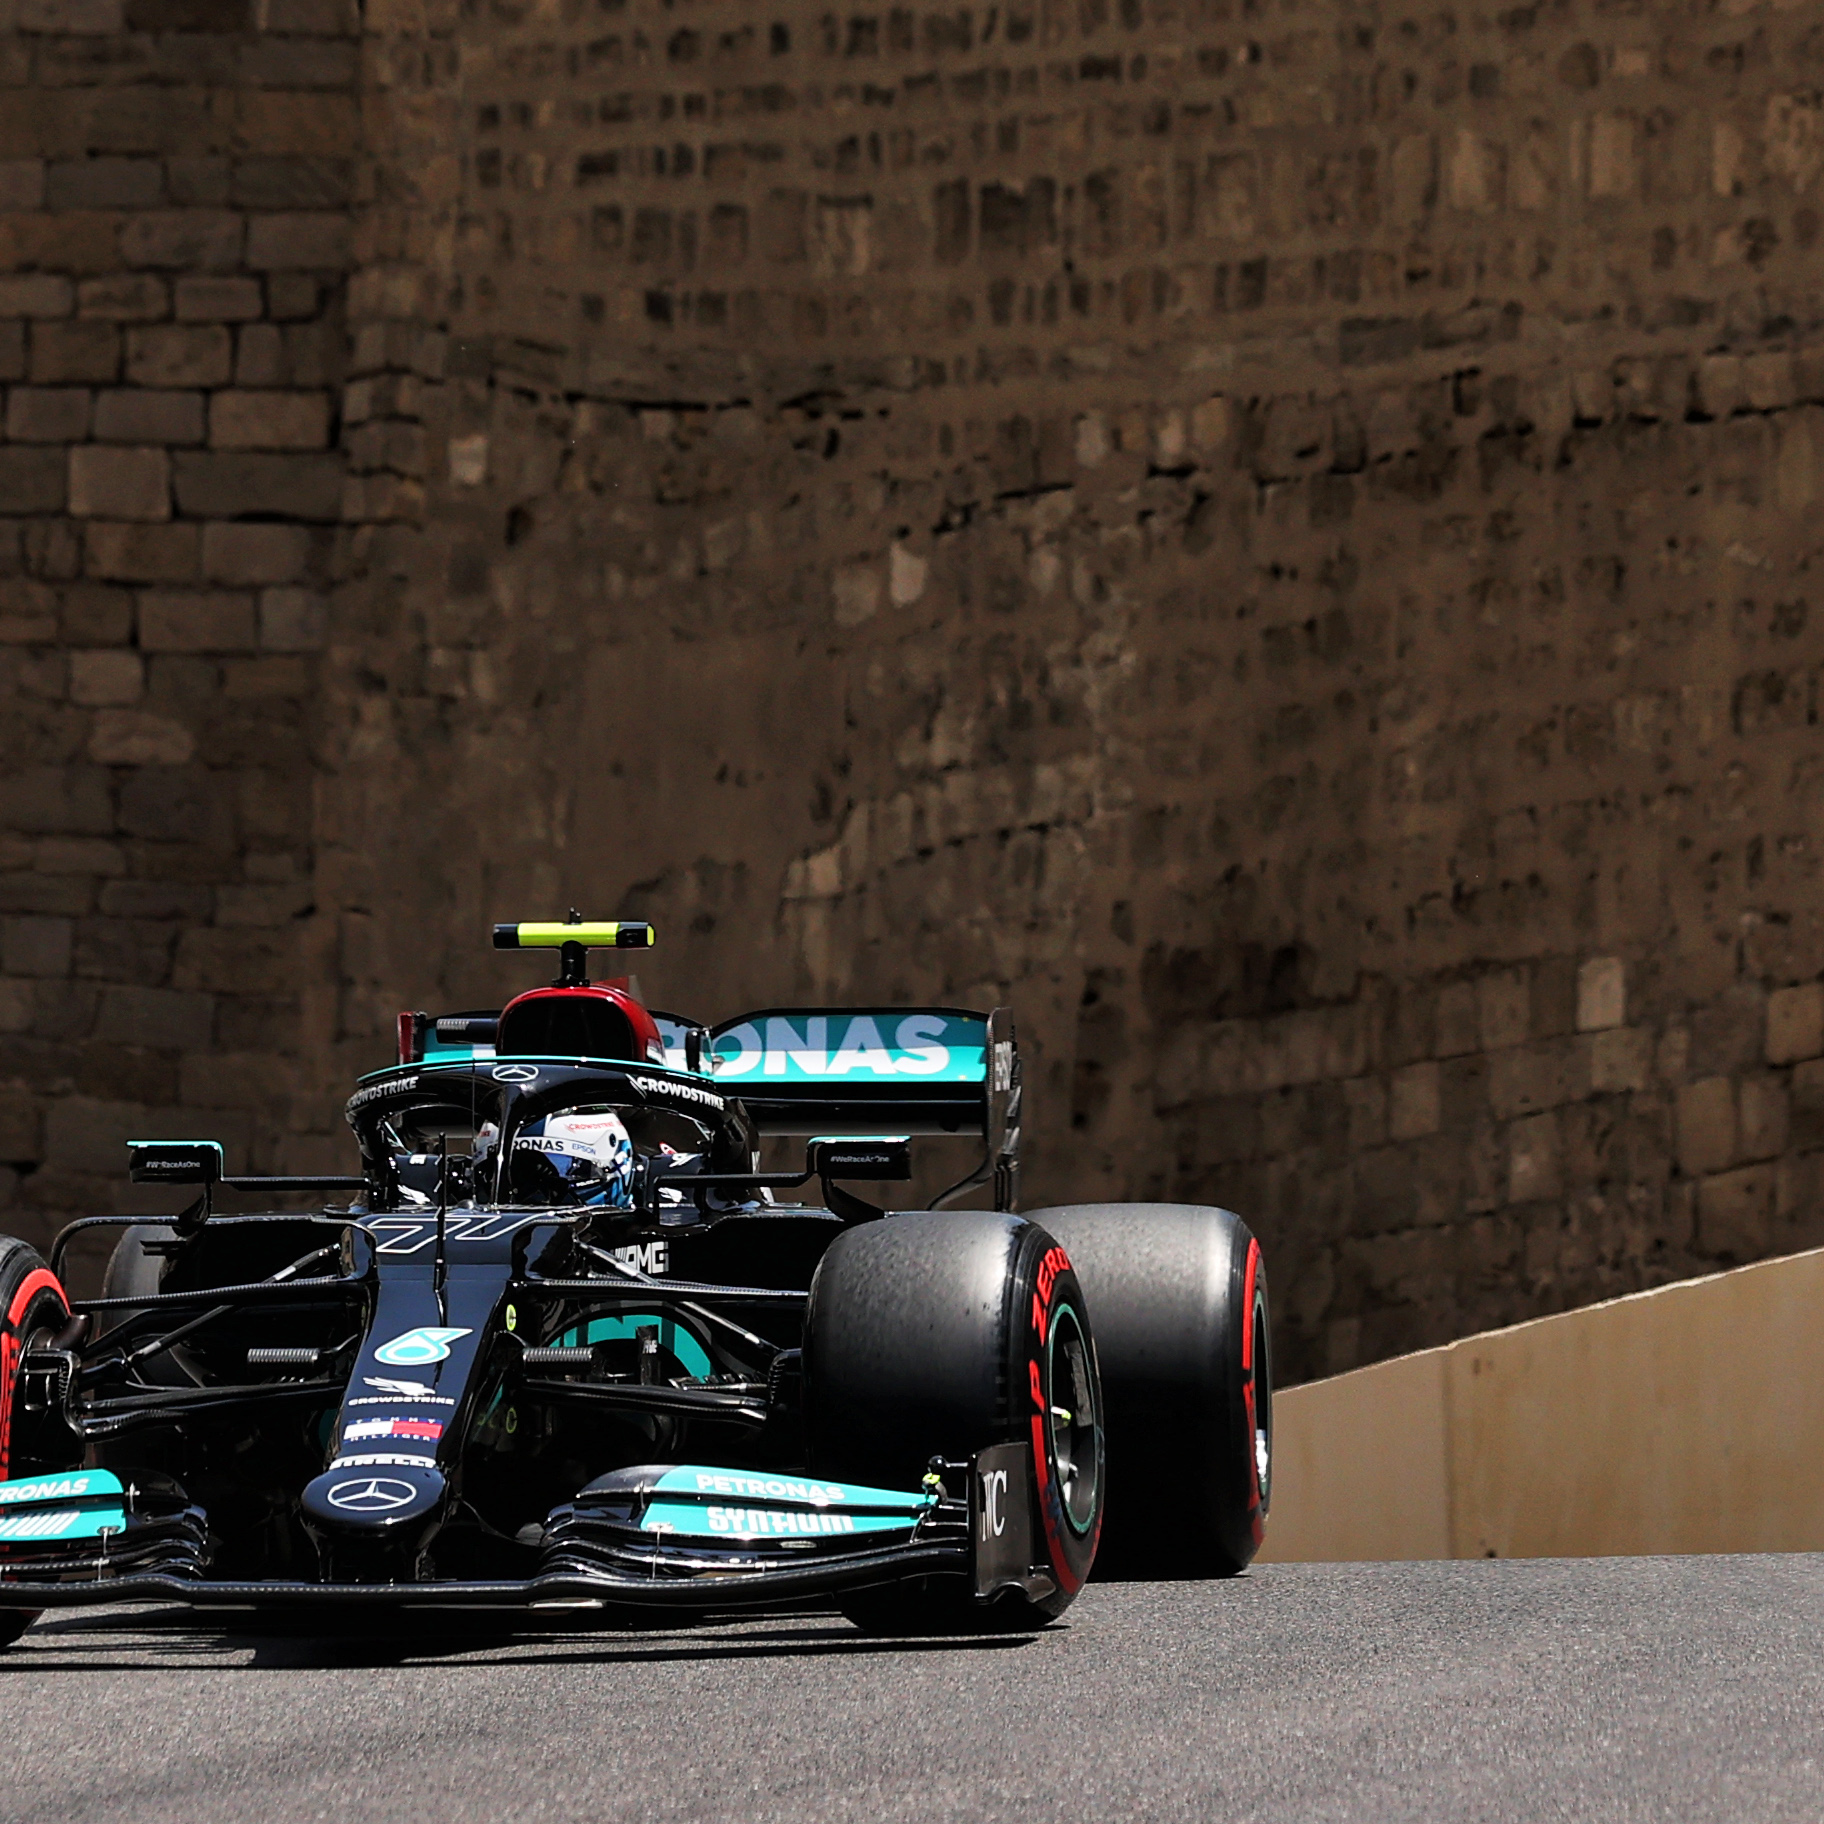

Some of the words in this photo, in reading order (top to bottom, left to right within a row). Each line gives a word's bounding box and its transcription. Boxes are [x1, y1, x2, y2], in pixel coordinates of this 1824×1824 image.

[638, 1076, 725, 1111] CROWDSTRIKE
[571, 1143, 597, 1155] EPSON
[348, 1396, 455, 1407] CROWDSTRIKE
[696, 1474, 845, 1500] PETRONAS
